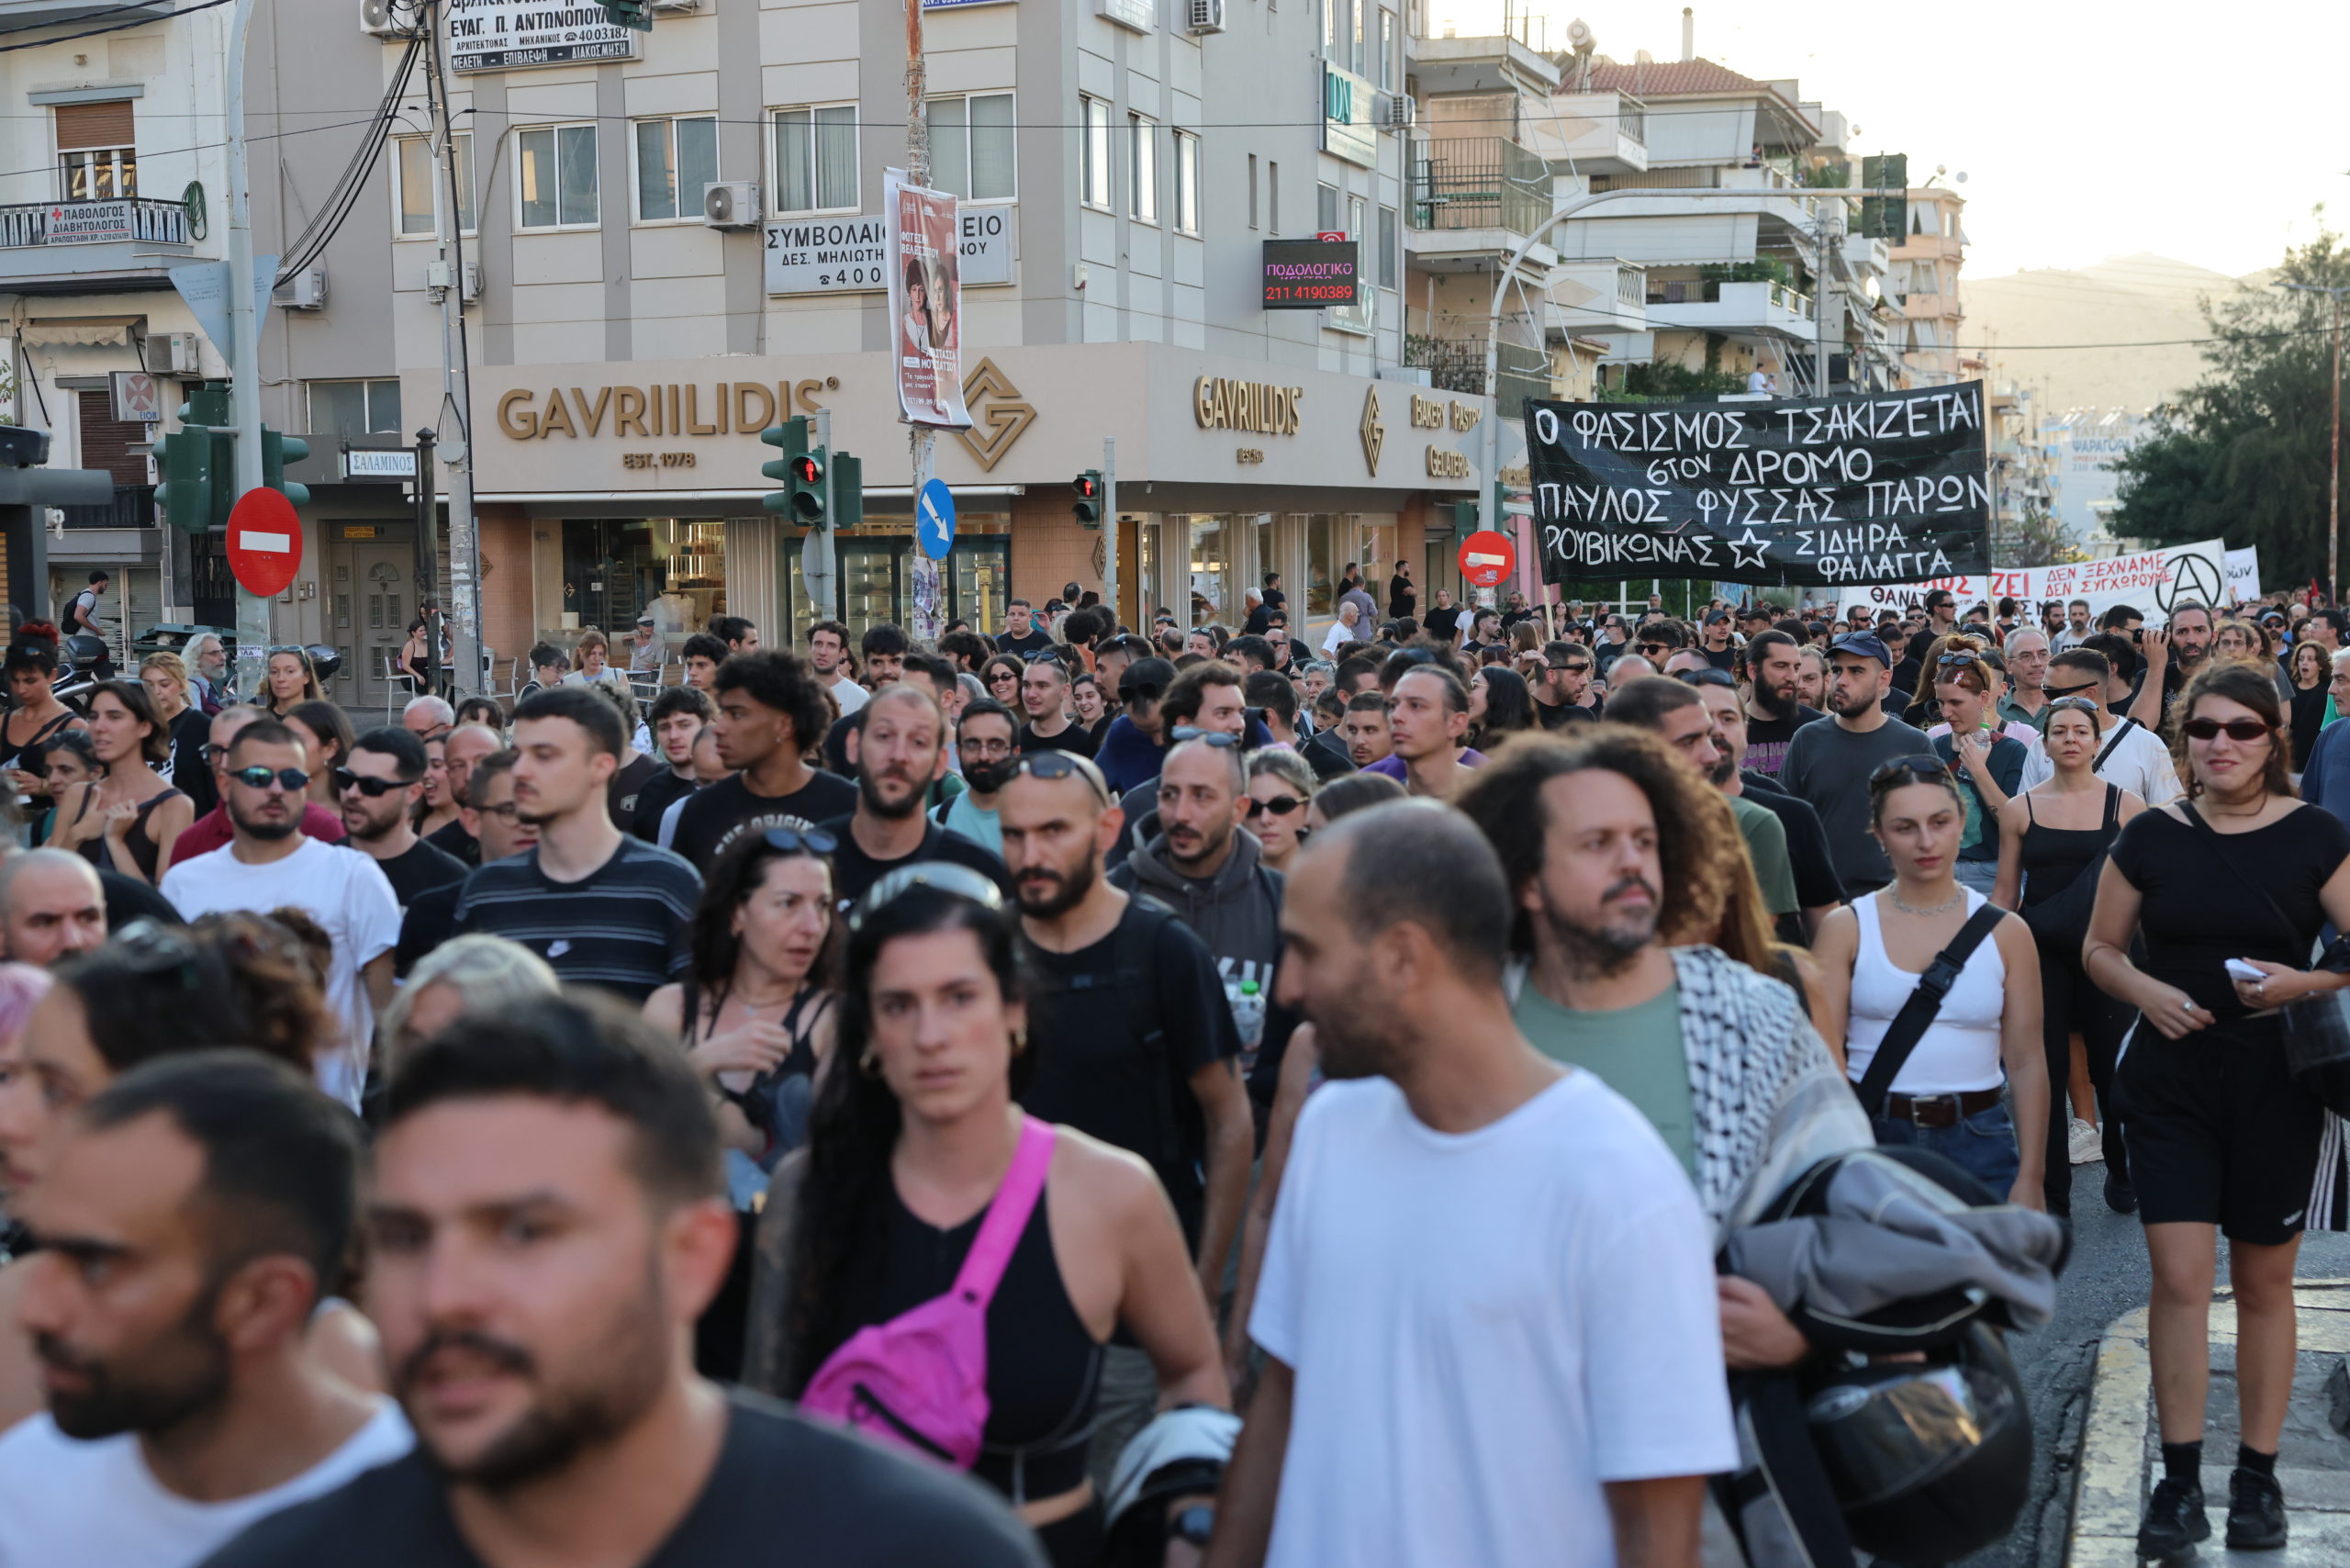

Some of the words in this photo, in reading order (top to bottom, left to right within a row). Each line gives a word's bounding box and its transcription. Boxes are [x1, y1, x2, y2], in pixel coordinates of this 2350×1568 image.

[451, 18, 486, 38] ΕΥΑΓ.
[515, 6, 610, 31] ΑΝΤΩΝΟΠΟΥΛ
[456, 38, 508, 51] ΑΡΧΙΤΕΚΤΟΝΑΣ
[519, 33, 561, 46] ΜΗΧΑΝΙΚΟΣ
[578, 27, 629, 41] 40.03.182
[453, 55, 483, 70] ΜΕΛΕΤΗ
[503, 49, 548, 65] ΕΠΙΒΛΕΨΗ
[571, 42, 626, 60] ΔΙΑΚΟΣΜΗΣΗ
[53, 219, 126, 233] ΔΙΑΒΗΤΟΛΟΓΟΣ
[64, 206, 125, 220] ΠΑΘΟΛΟΓΟΣ
[782, 253, 811, 266] ΔΕΣ.
[1267, 263, 1352, 276] ΠΟΔΟΛΟΓΙΚΟ
[1266, 287, 1290, 300] 211
[1293, 286, 1352, 299] 4190389
[1193, 375, 1301, 435] GAVRIILIDIS
[1411, 394, 1446, 429] BAKERY
[1536, 409, 1559, 445] Ο
[1572, 409, 1749, 452] ΦΑΣΙΣΜΟΣ
[1775, 389, 1980, 444] ΤΣΑΚΙΖΕΤΑΙ
[353, 454, 412, 472] ΣΑΛΑΜΙΝΟΣ
[660, 453, 696, 468] 1978
[1729, 446, 1874, 486] ΔΡΟΜΟ
[1538, 483, 1673, 524] ΠΑΥΛΟΣ
[1695, 487, 1847, 525] ΦΥΣΣΑΣ
[1863, 472, 1991, 519] ΠΑΡΩΝ
[1545, 525, 1720, 566] ΡΟΥΒΙΚΩΝΑΣ
[1796, 522, 1908, 555] ΣΙΔΗΡΑ
[1818, 549, 1952, 582] ΦΑΛΑΓΓΑ
[2047, 566, 2077, 583] ΔΕΝ
[2084, 553, 2167, 580] ΞΕΧΝΑΜΕ
[2045, 582, 2072, 598] ΔΕΝ
[2080, 569, 2174, 595] ΣΥΓΧΩΡΟΥΜΕ
